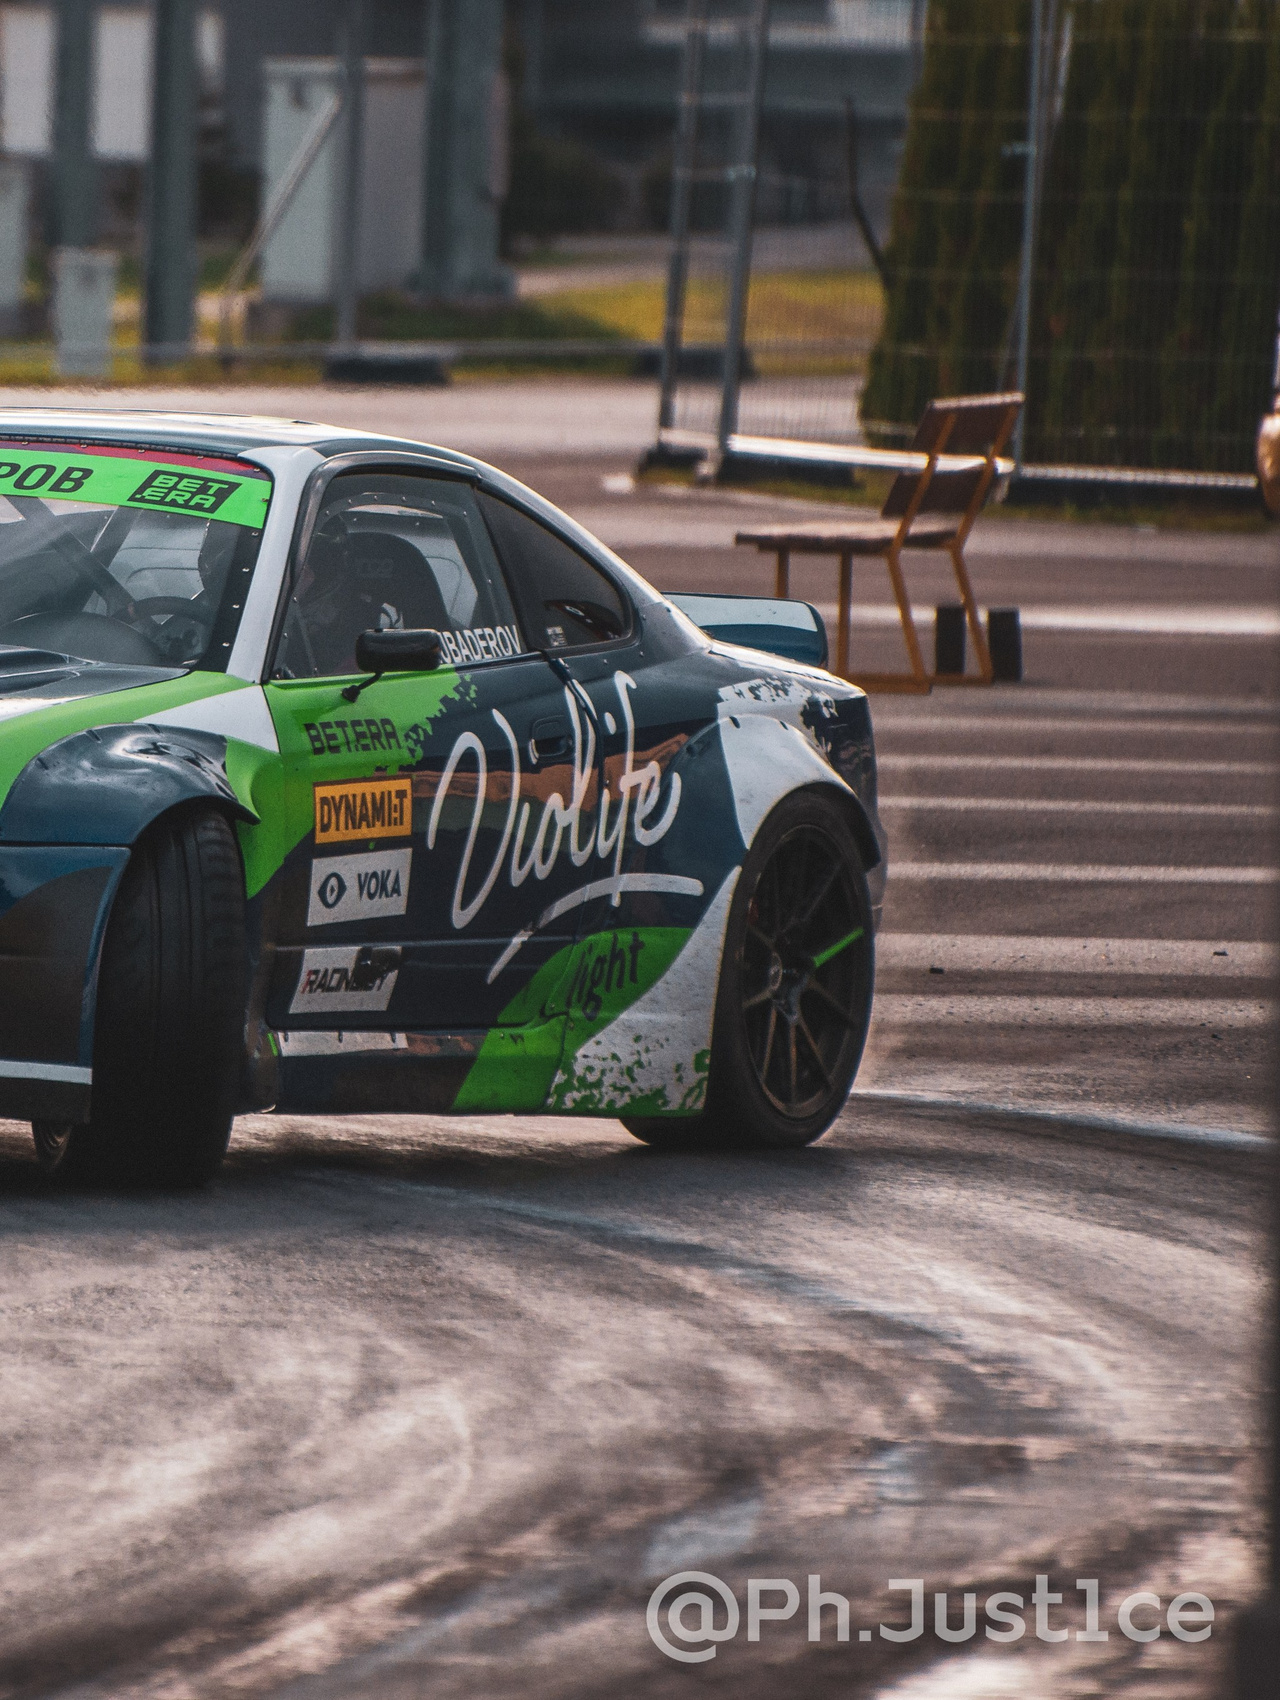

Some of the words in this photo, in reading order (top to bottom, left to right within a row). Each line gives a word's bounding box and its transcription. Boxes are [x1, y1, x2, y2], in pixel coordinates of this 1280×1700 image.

[151, 474, 229, 495] BET
[439, 624, 522, 664] UBADEROV
[357, 869, 402, 900] VOKA
